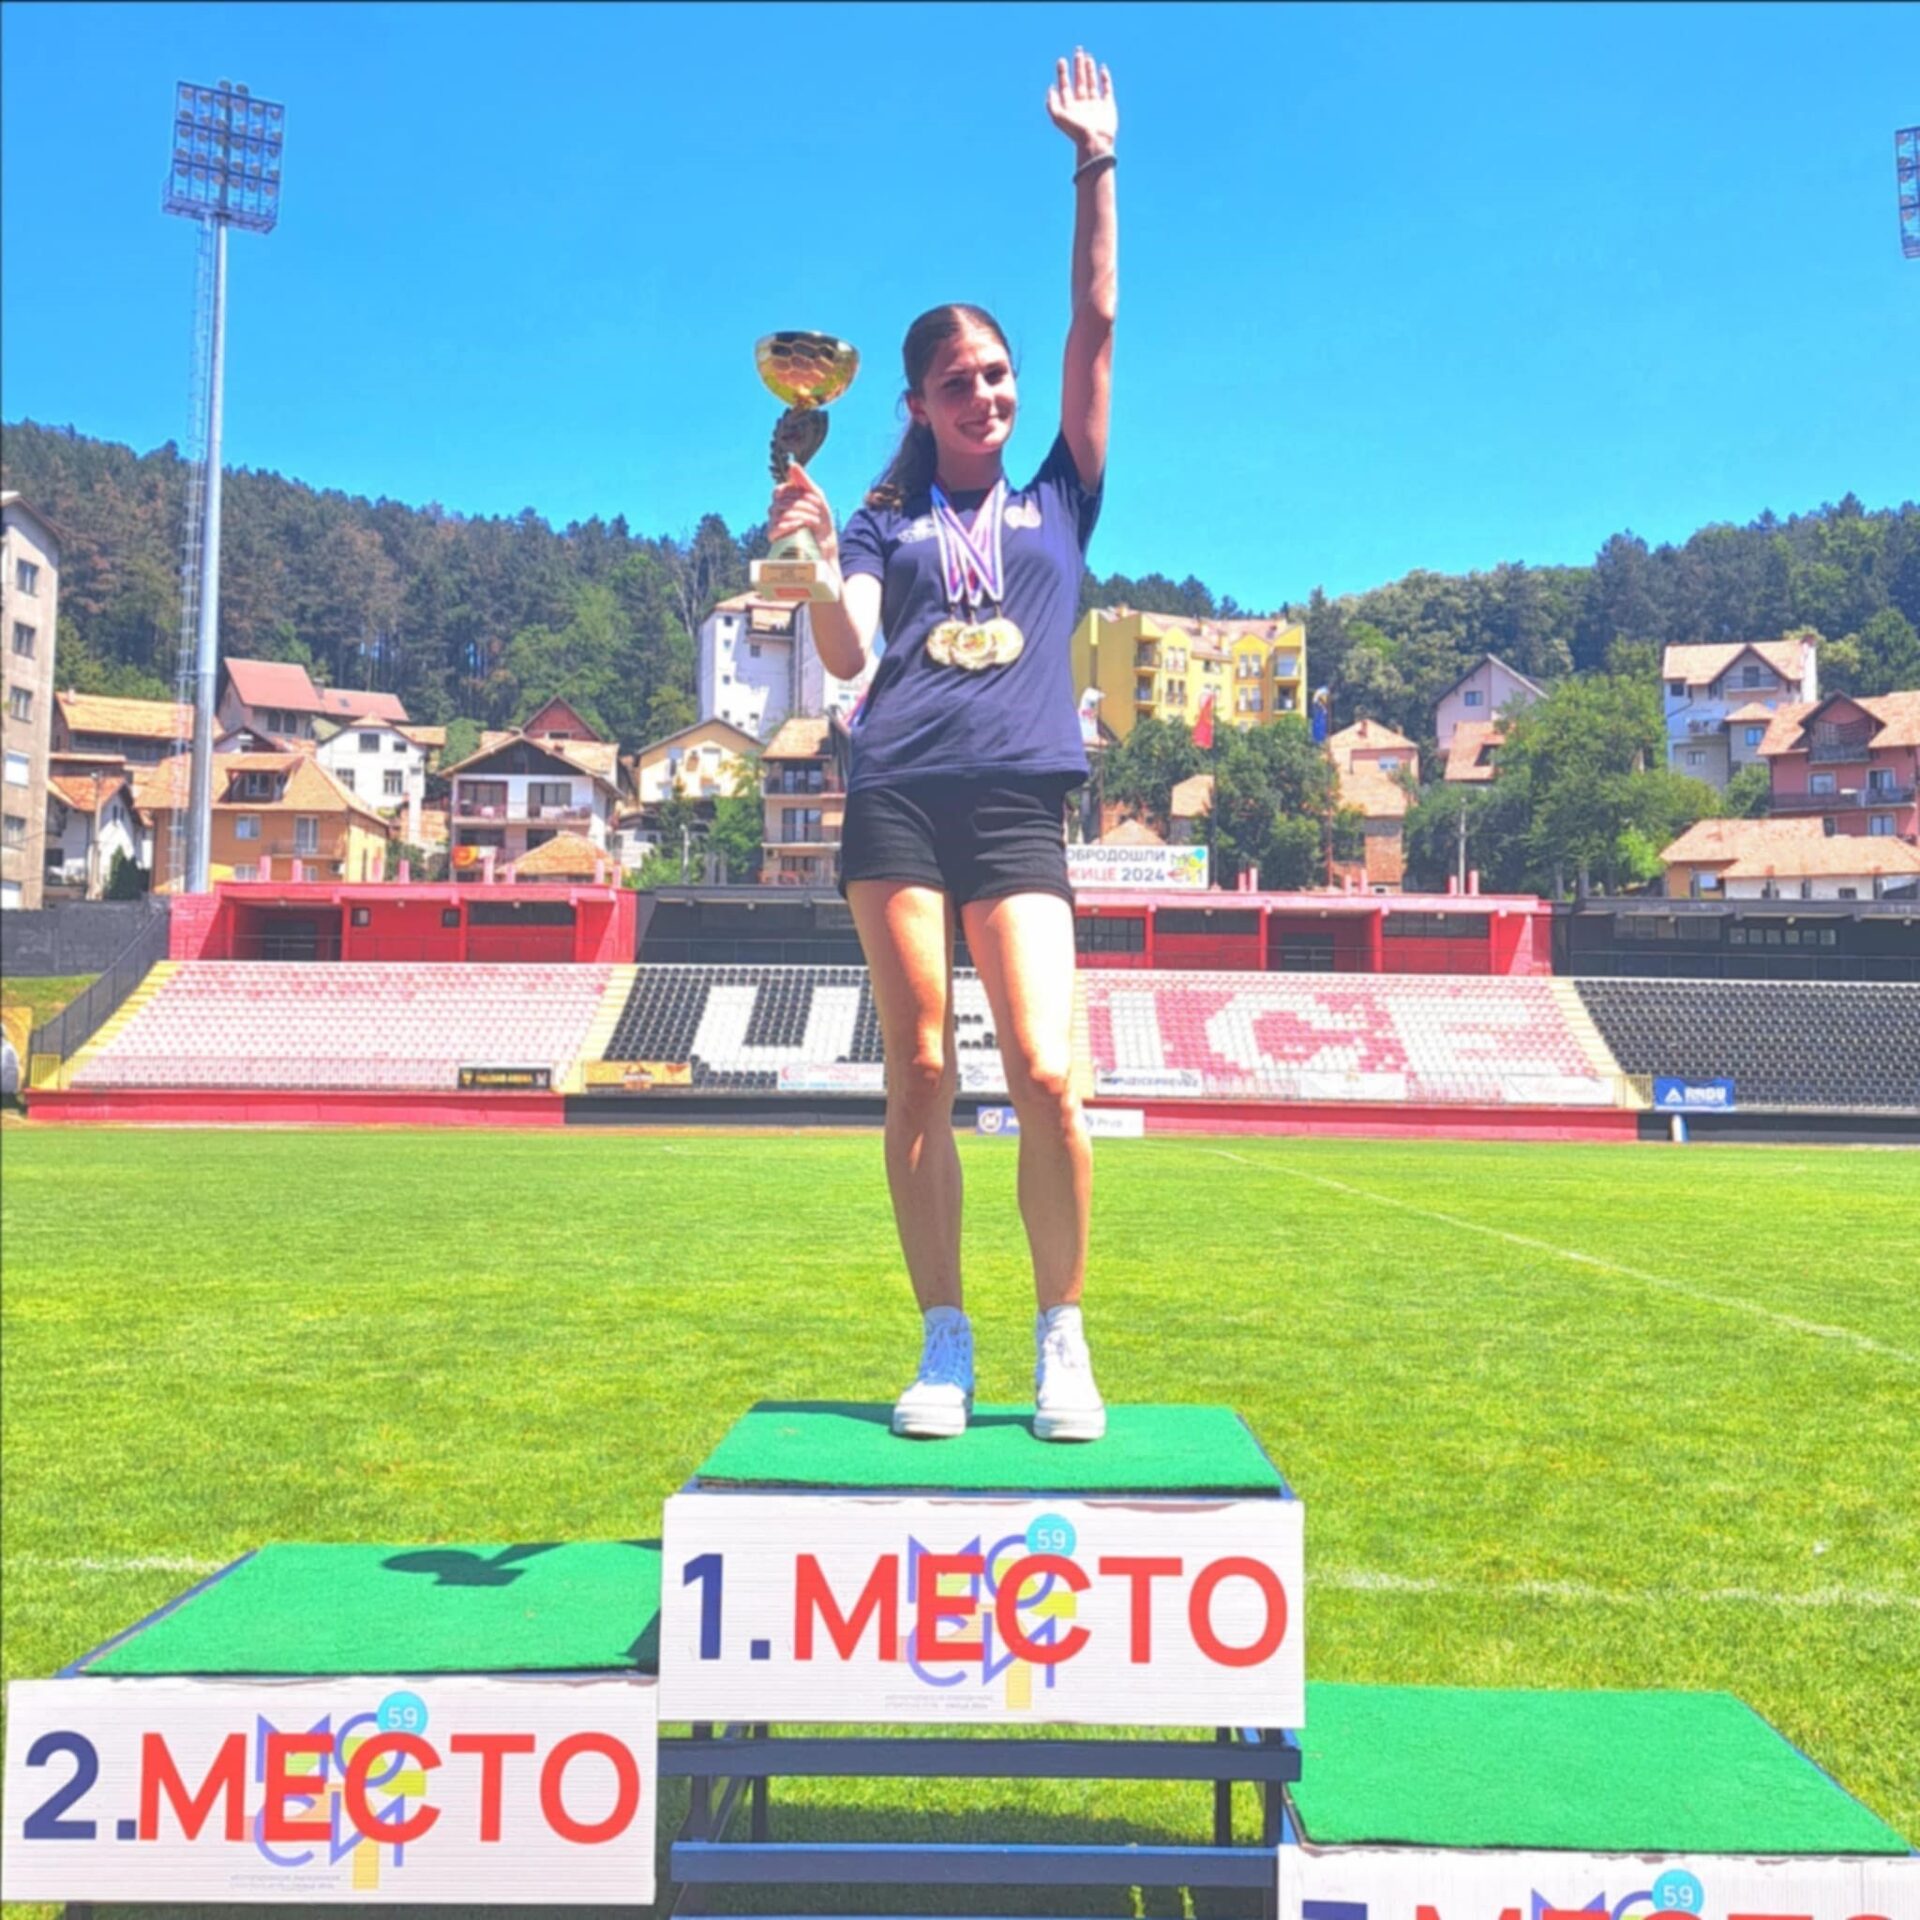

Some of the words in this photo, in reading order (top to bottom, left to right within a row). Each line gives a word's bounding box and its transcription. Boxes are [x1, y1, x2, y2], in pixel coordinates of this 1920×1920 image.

[1065, 848, 1166, 863] ОБРОДОШЛИ
[1066, 867, 1117, 881] ЖИЦЕ
[1121, 867, 1165, 882] 2024
[1036, 1528, 1067, 1550] 59
[793, 1553, 1288, 1667] МЕСТО
[387, 1706, 418, 1729] 59
[1663, 1885, 1694, 1907] 59
